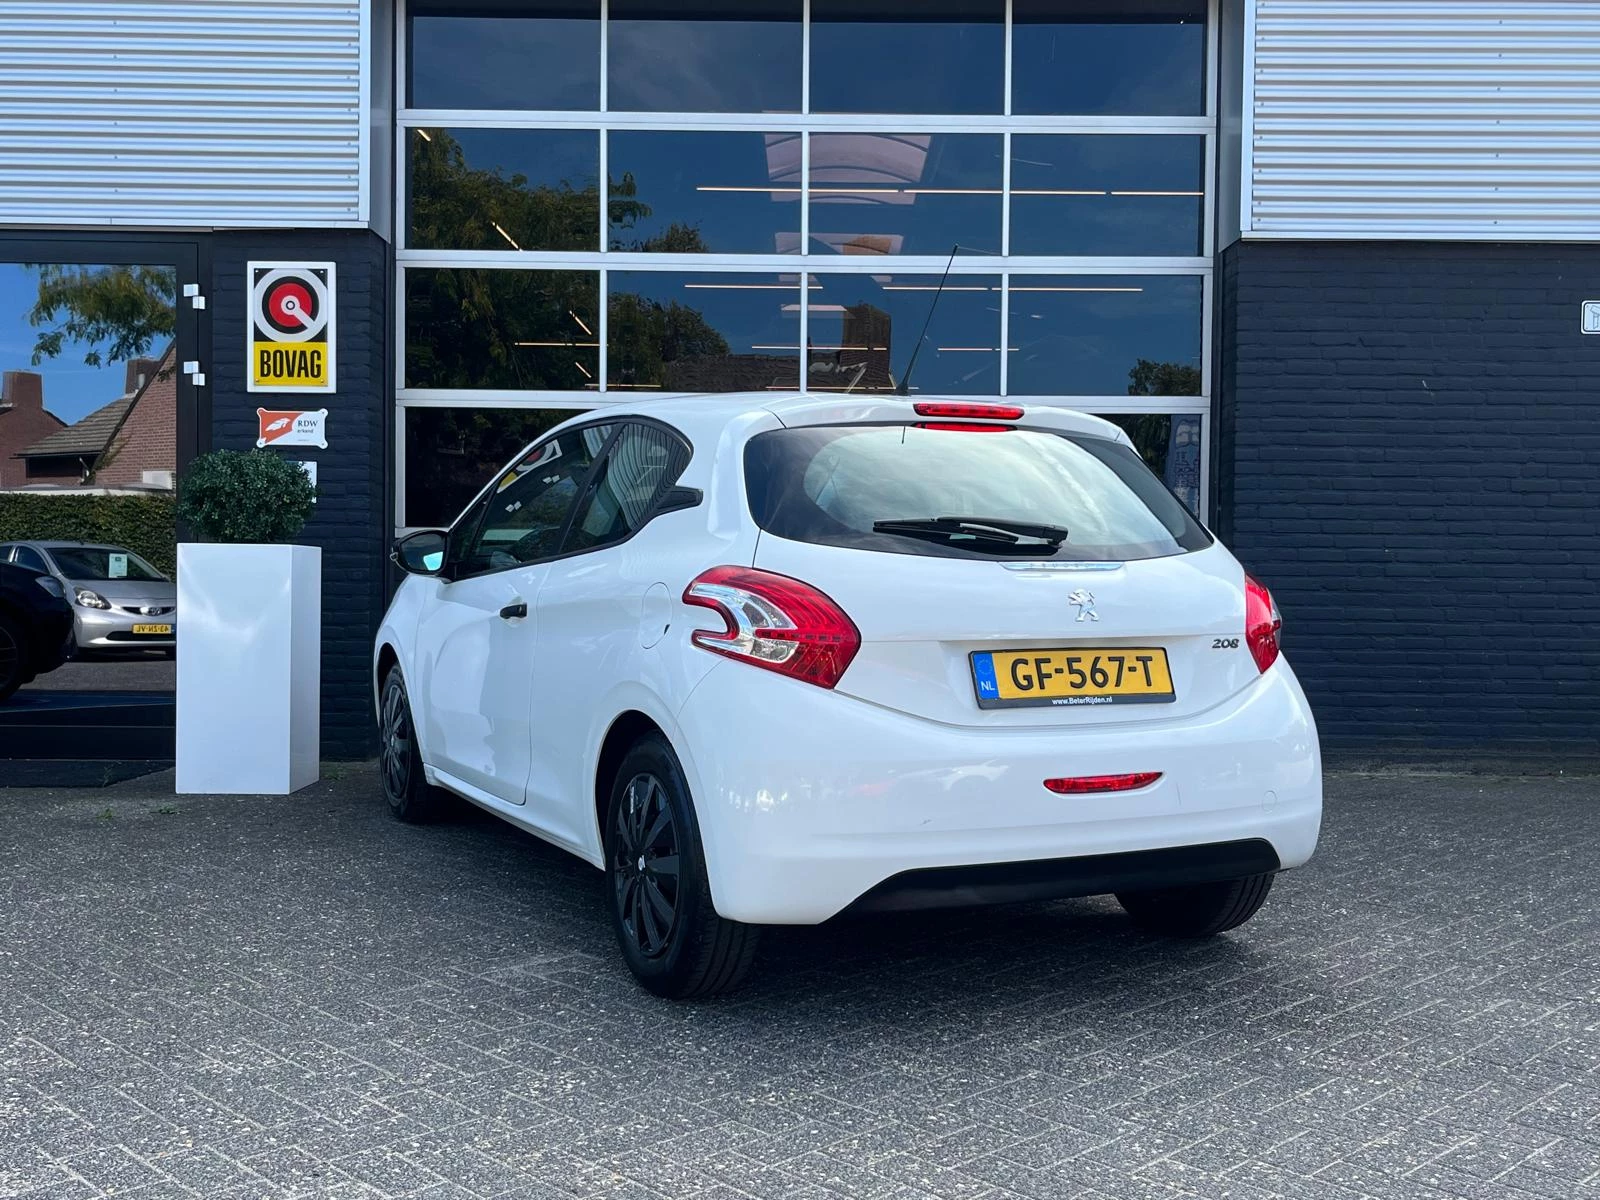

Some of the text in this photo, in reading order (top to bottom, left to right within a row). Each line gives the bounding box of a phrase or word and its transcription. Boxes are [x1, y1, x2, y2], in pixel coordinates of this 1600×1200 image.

[260, 350, 321, 378] BOVAG
[1212, 638, 1240, 649] 208
[1010, 656, 1153, 691] GF-567-T
[981, 680, 995, 691] NL
[1052, 696, 1113, 705] www.BeterRijden.nl
